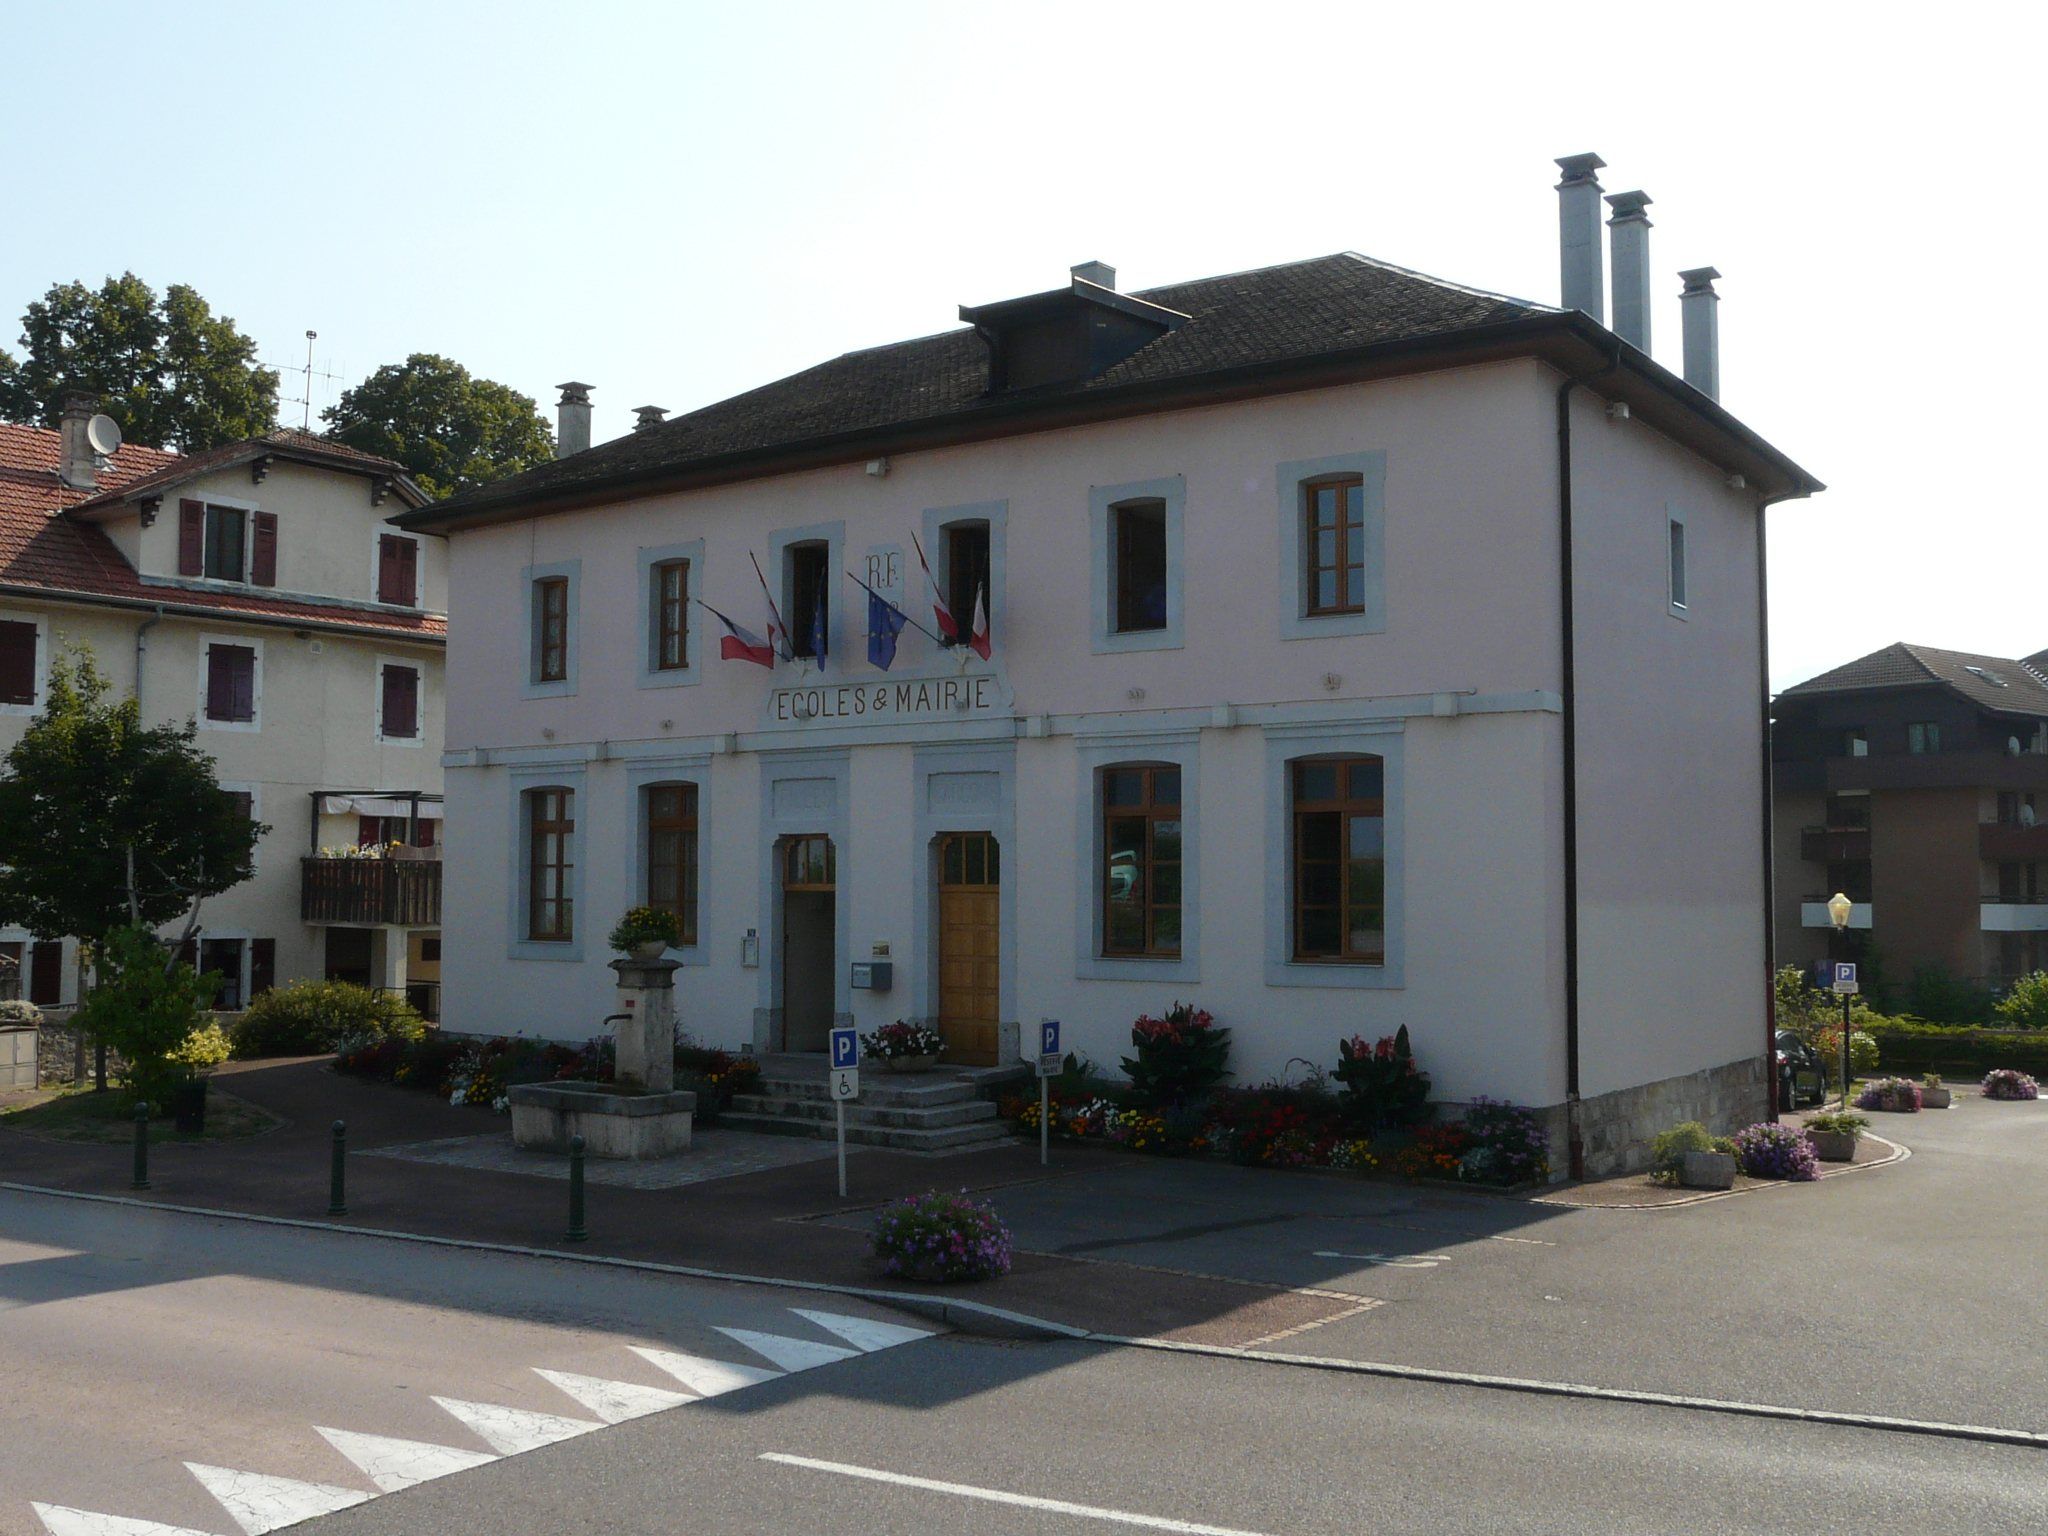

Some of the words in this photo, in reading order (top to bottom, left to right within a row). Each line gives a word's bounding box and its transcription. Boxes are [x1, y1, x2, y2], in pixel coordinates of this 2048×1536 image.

[778, 688, 866, 720] ECOLES
[873, 688, 887, 711] &
[896, 679, 990, 712] MAIRIE
[1841, 967, 1850, 979] P
[838, 1037, 851, 1062] P
[1046, 1027, 1055, 1049] P
